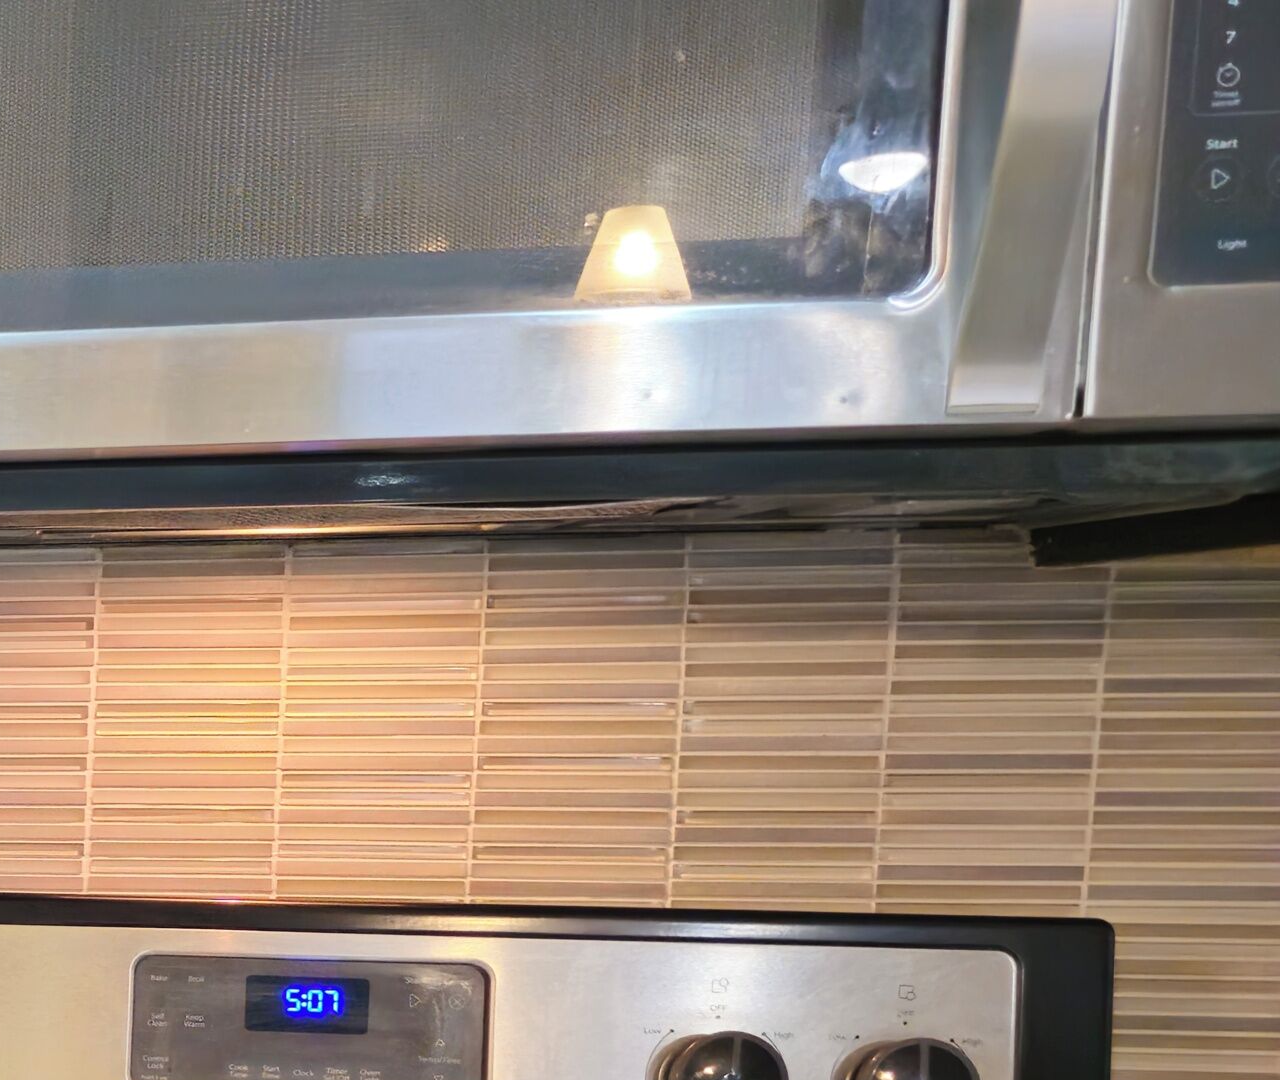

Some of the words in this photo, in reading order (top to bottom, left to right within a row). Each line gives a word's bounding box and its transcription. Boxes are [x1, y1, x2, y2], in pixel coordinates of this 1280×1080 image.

[1225, 30, 1237, 44] 7
[1206, 138, 1238, 149] Start
[1217, 238, 1247, 250] Light
[285, 988, 339, 1013] 5:07
[293, 1069, 314, 1077] Clock
